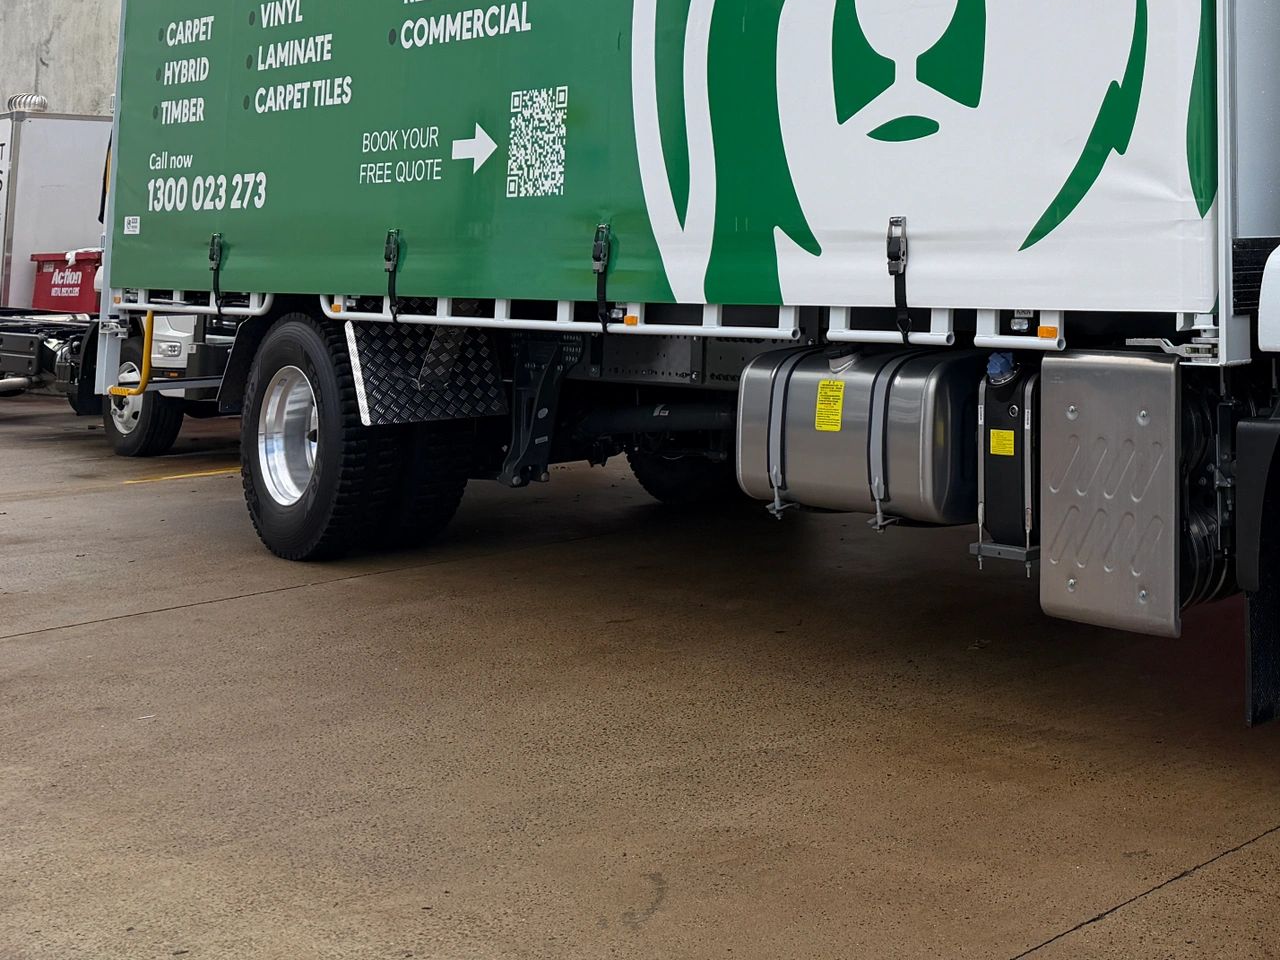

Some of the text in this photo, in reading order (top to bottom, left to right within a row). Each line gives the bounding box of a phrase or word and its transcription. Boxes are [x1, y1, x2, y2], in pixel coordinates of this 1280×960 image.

[167, 16, 214, 46] CARPET
[401, 1, 531, 48] COMMERCIAL
[258, 34, 332, 70] LAMINATE
[164, 57, 209, 85] HYBRID
[255, 76, 352, 113] CARPET TILES
[161, 98, 204, 124] TIMBER
[363, 127, 438, 152] BOOK YOUR
[150, 152, 193, 169] Call now
[360, 159, 442, 183] FREE QUOTE
[148, 172, 266, 211] 1300 023 273
[51, 269, 82, 285] Action
